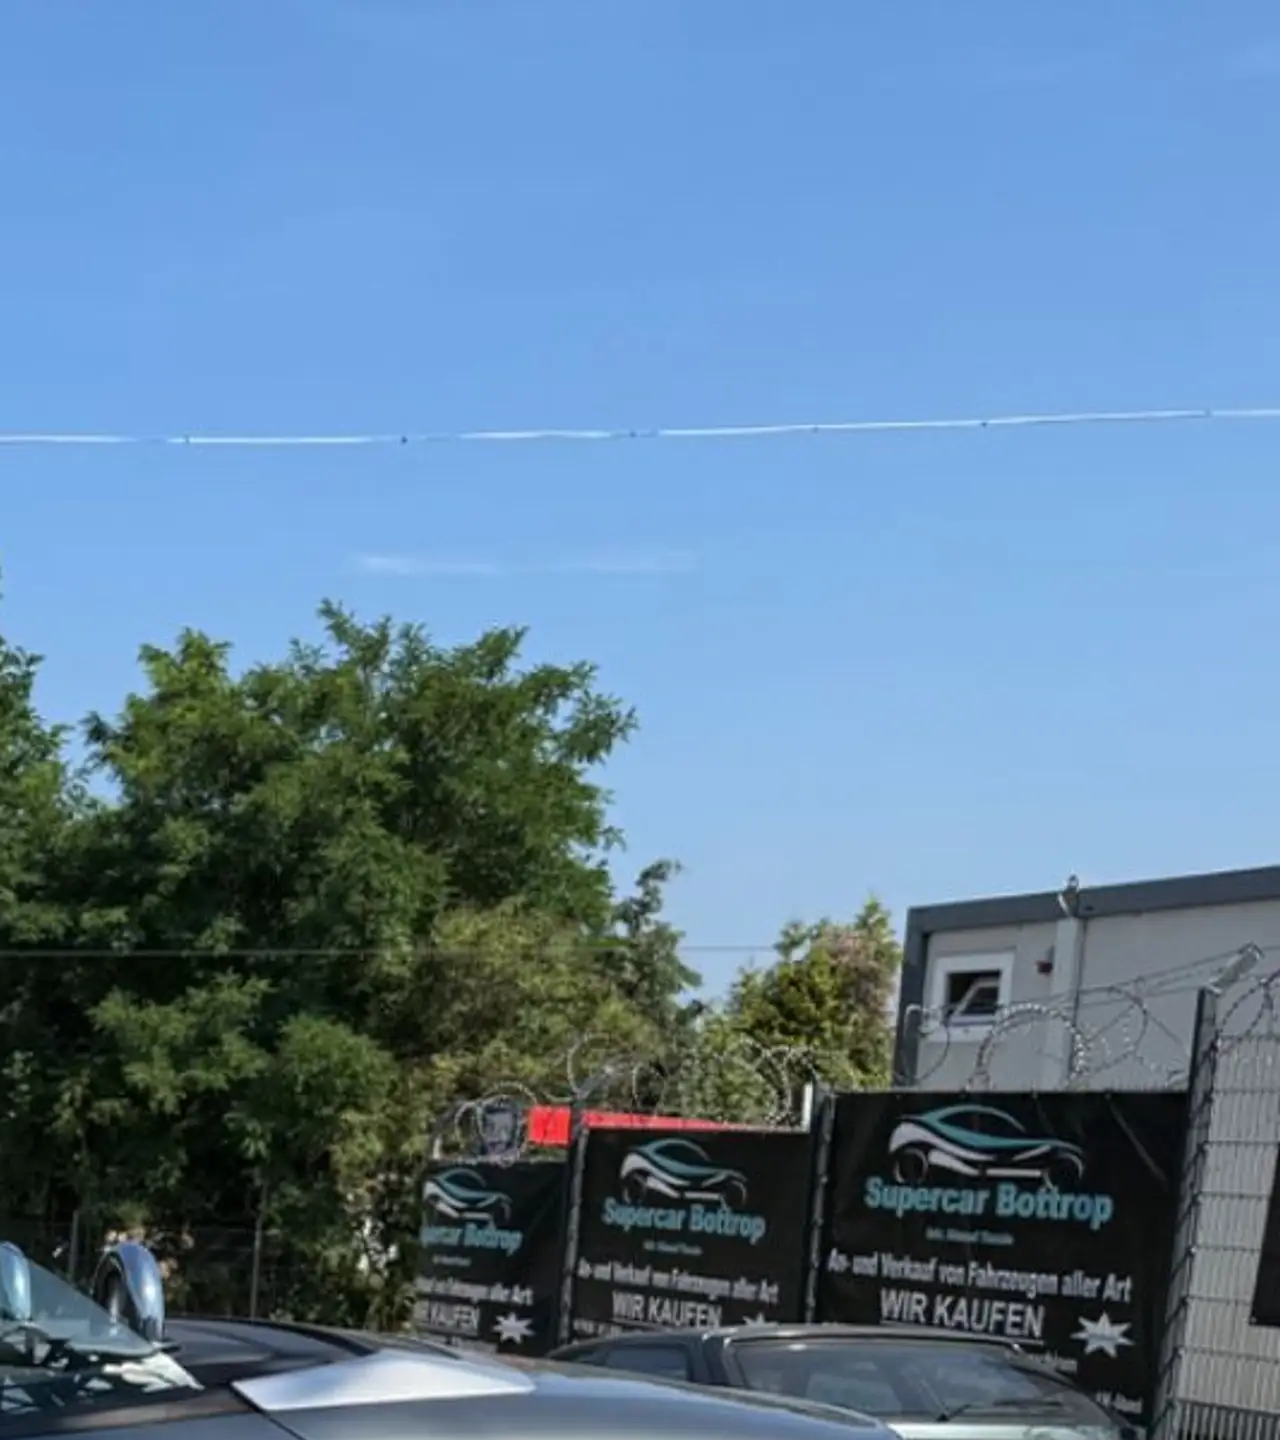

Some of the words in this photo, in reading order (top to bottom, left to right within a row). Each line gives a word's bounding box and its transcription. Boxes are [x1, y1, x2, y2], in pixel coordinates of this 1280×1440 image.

[601, 1197, 686, 1232] Supercar
[690, 1204, 766, 1245] Bottrop
[864, 1176, 989, 1218] Supercar
[995, 1183, 1114, 1231] Bottrop
[853, 1252, 877, 1276] und
[881, 1252, 937, 1282] Verkauf
[939, 1263, 965, 1286] von
[968, 1260, 1058, 1297] Fahrzeugen
[1061, 1270, 1100, 1297] aller
[1103, 1273, 1132, 1302] Art
[612, 1290, 644, 1322] WIR
[648, 1295, 722, 1332] KAUFEN
[880, 1287, 928, 1325] WIR
[933, 1294, 1045, 1338] KAUFEN
